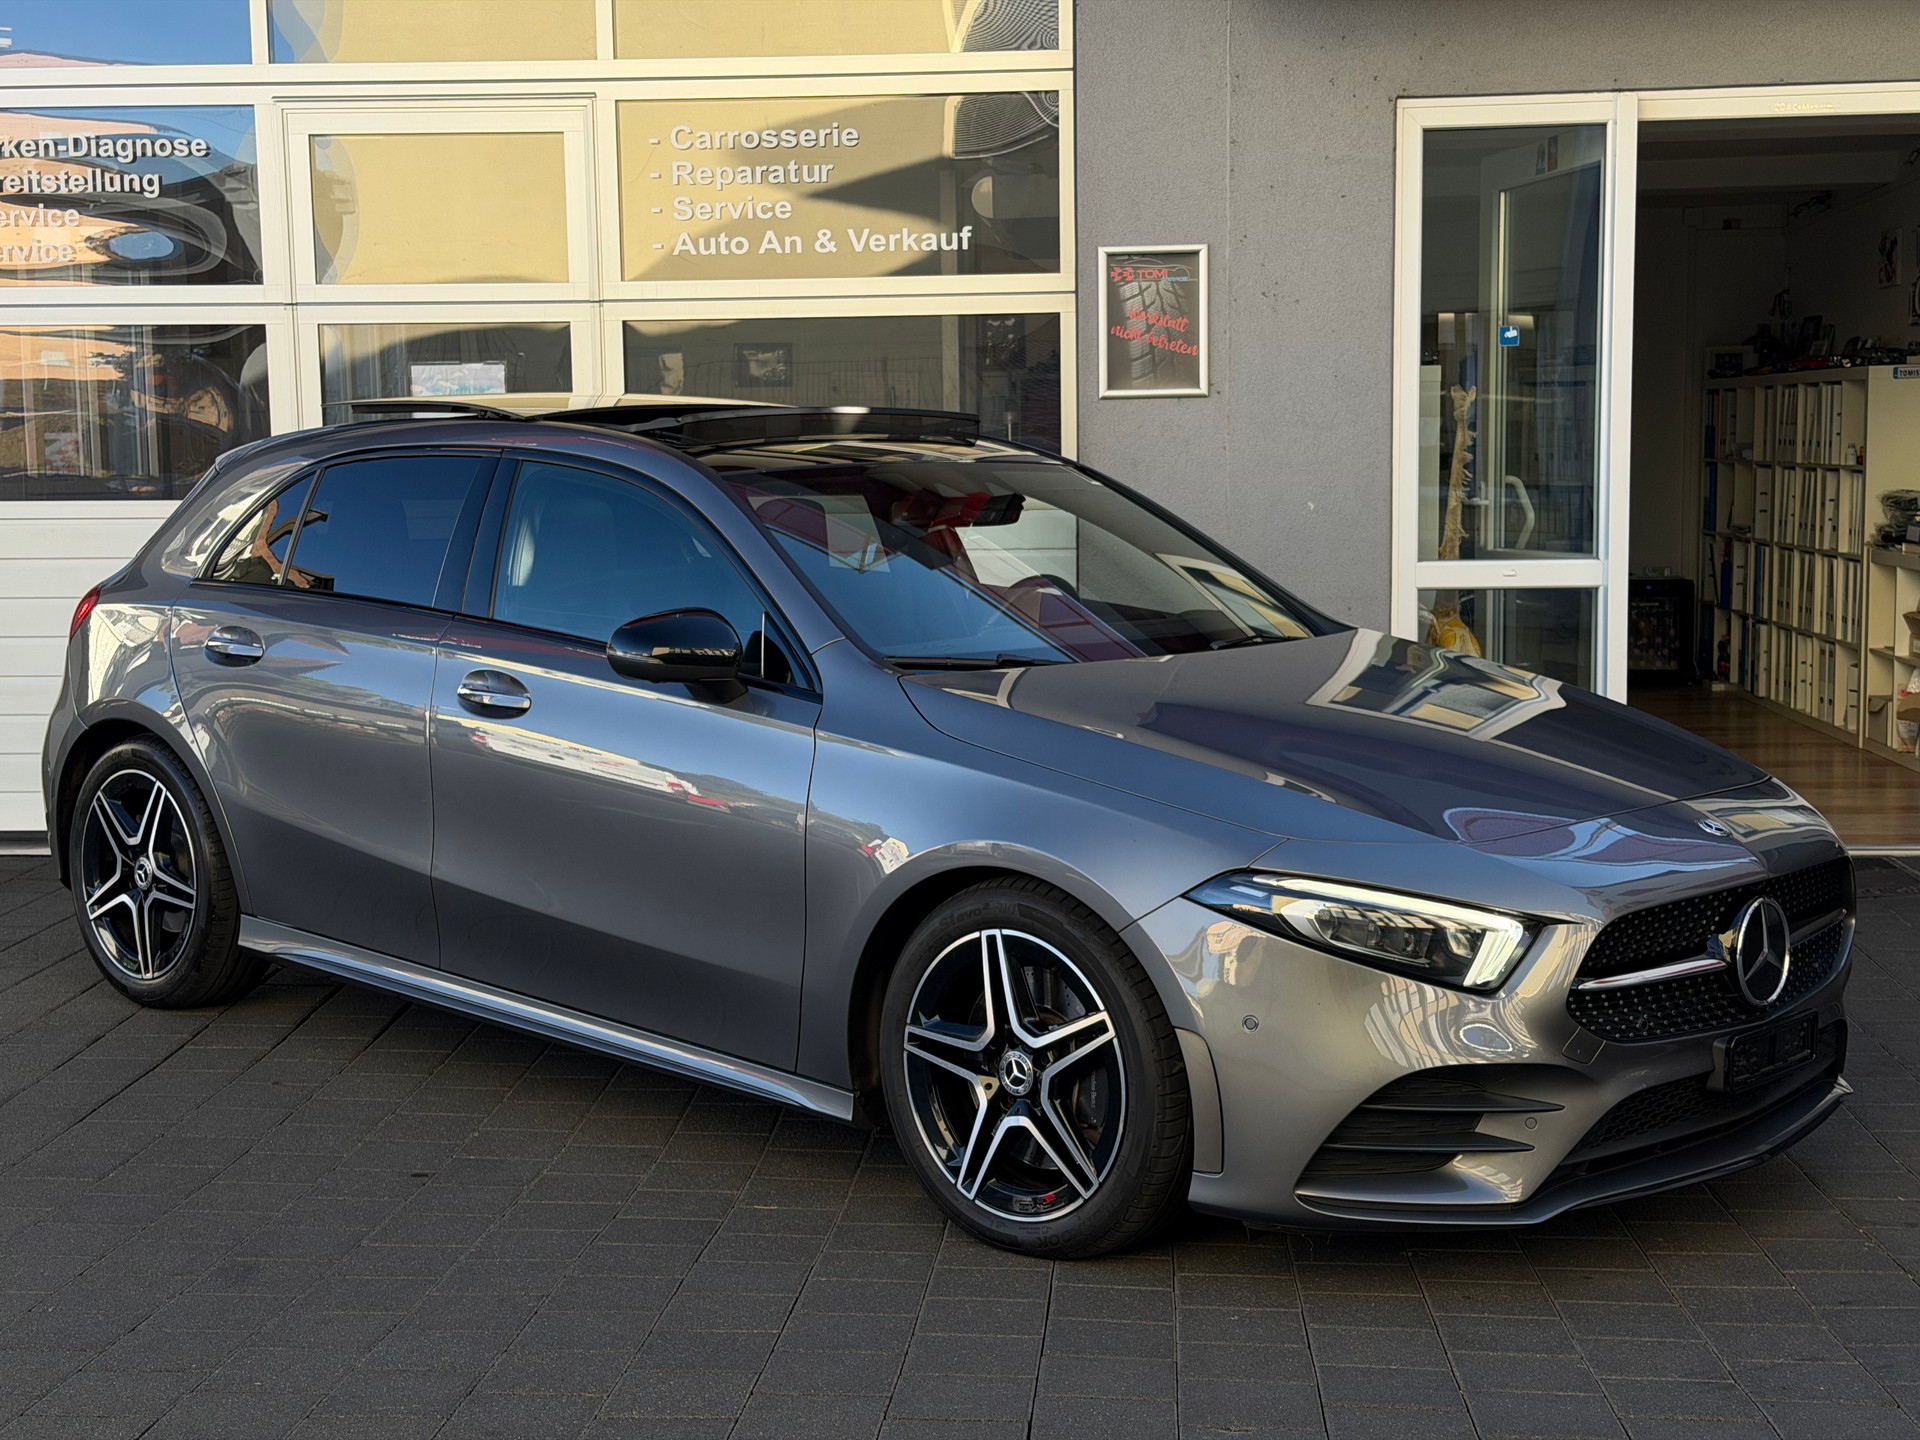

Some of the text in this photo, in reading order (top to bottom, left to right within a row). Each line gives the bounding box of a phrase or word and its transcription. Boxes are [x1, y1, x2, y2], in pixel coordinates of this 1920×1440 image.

[670, 122, 860, 149] Carrosserie
[671, 160, 834, 190] Reparatur
[672, 196, 792, 220] Service
[0, 239, 74, 262] rvice
[672, 232, 749, 255] Auto
[758, 230, 803, 253] An
[814, 229, 838, 253] &
[847, 226, 972, 252] Verkauf
[1137, 268, 1168, 280] TOMI
[1146, 330, 1199, 355] betreten
